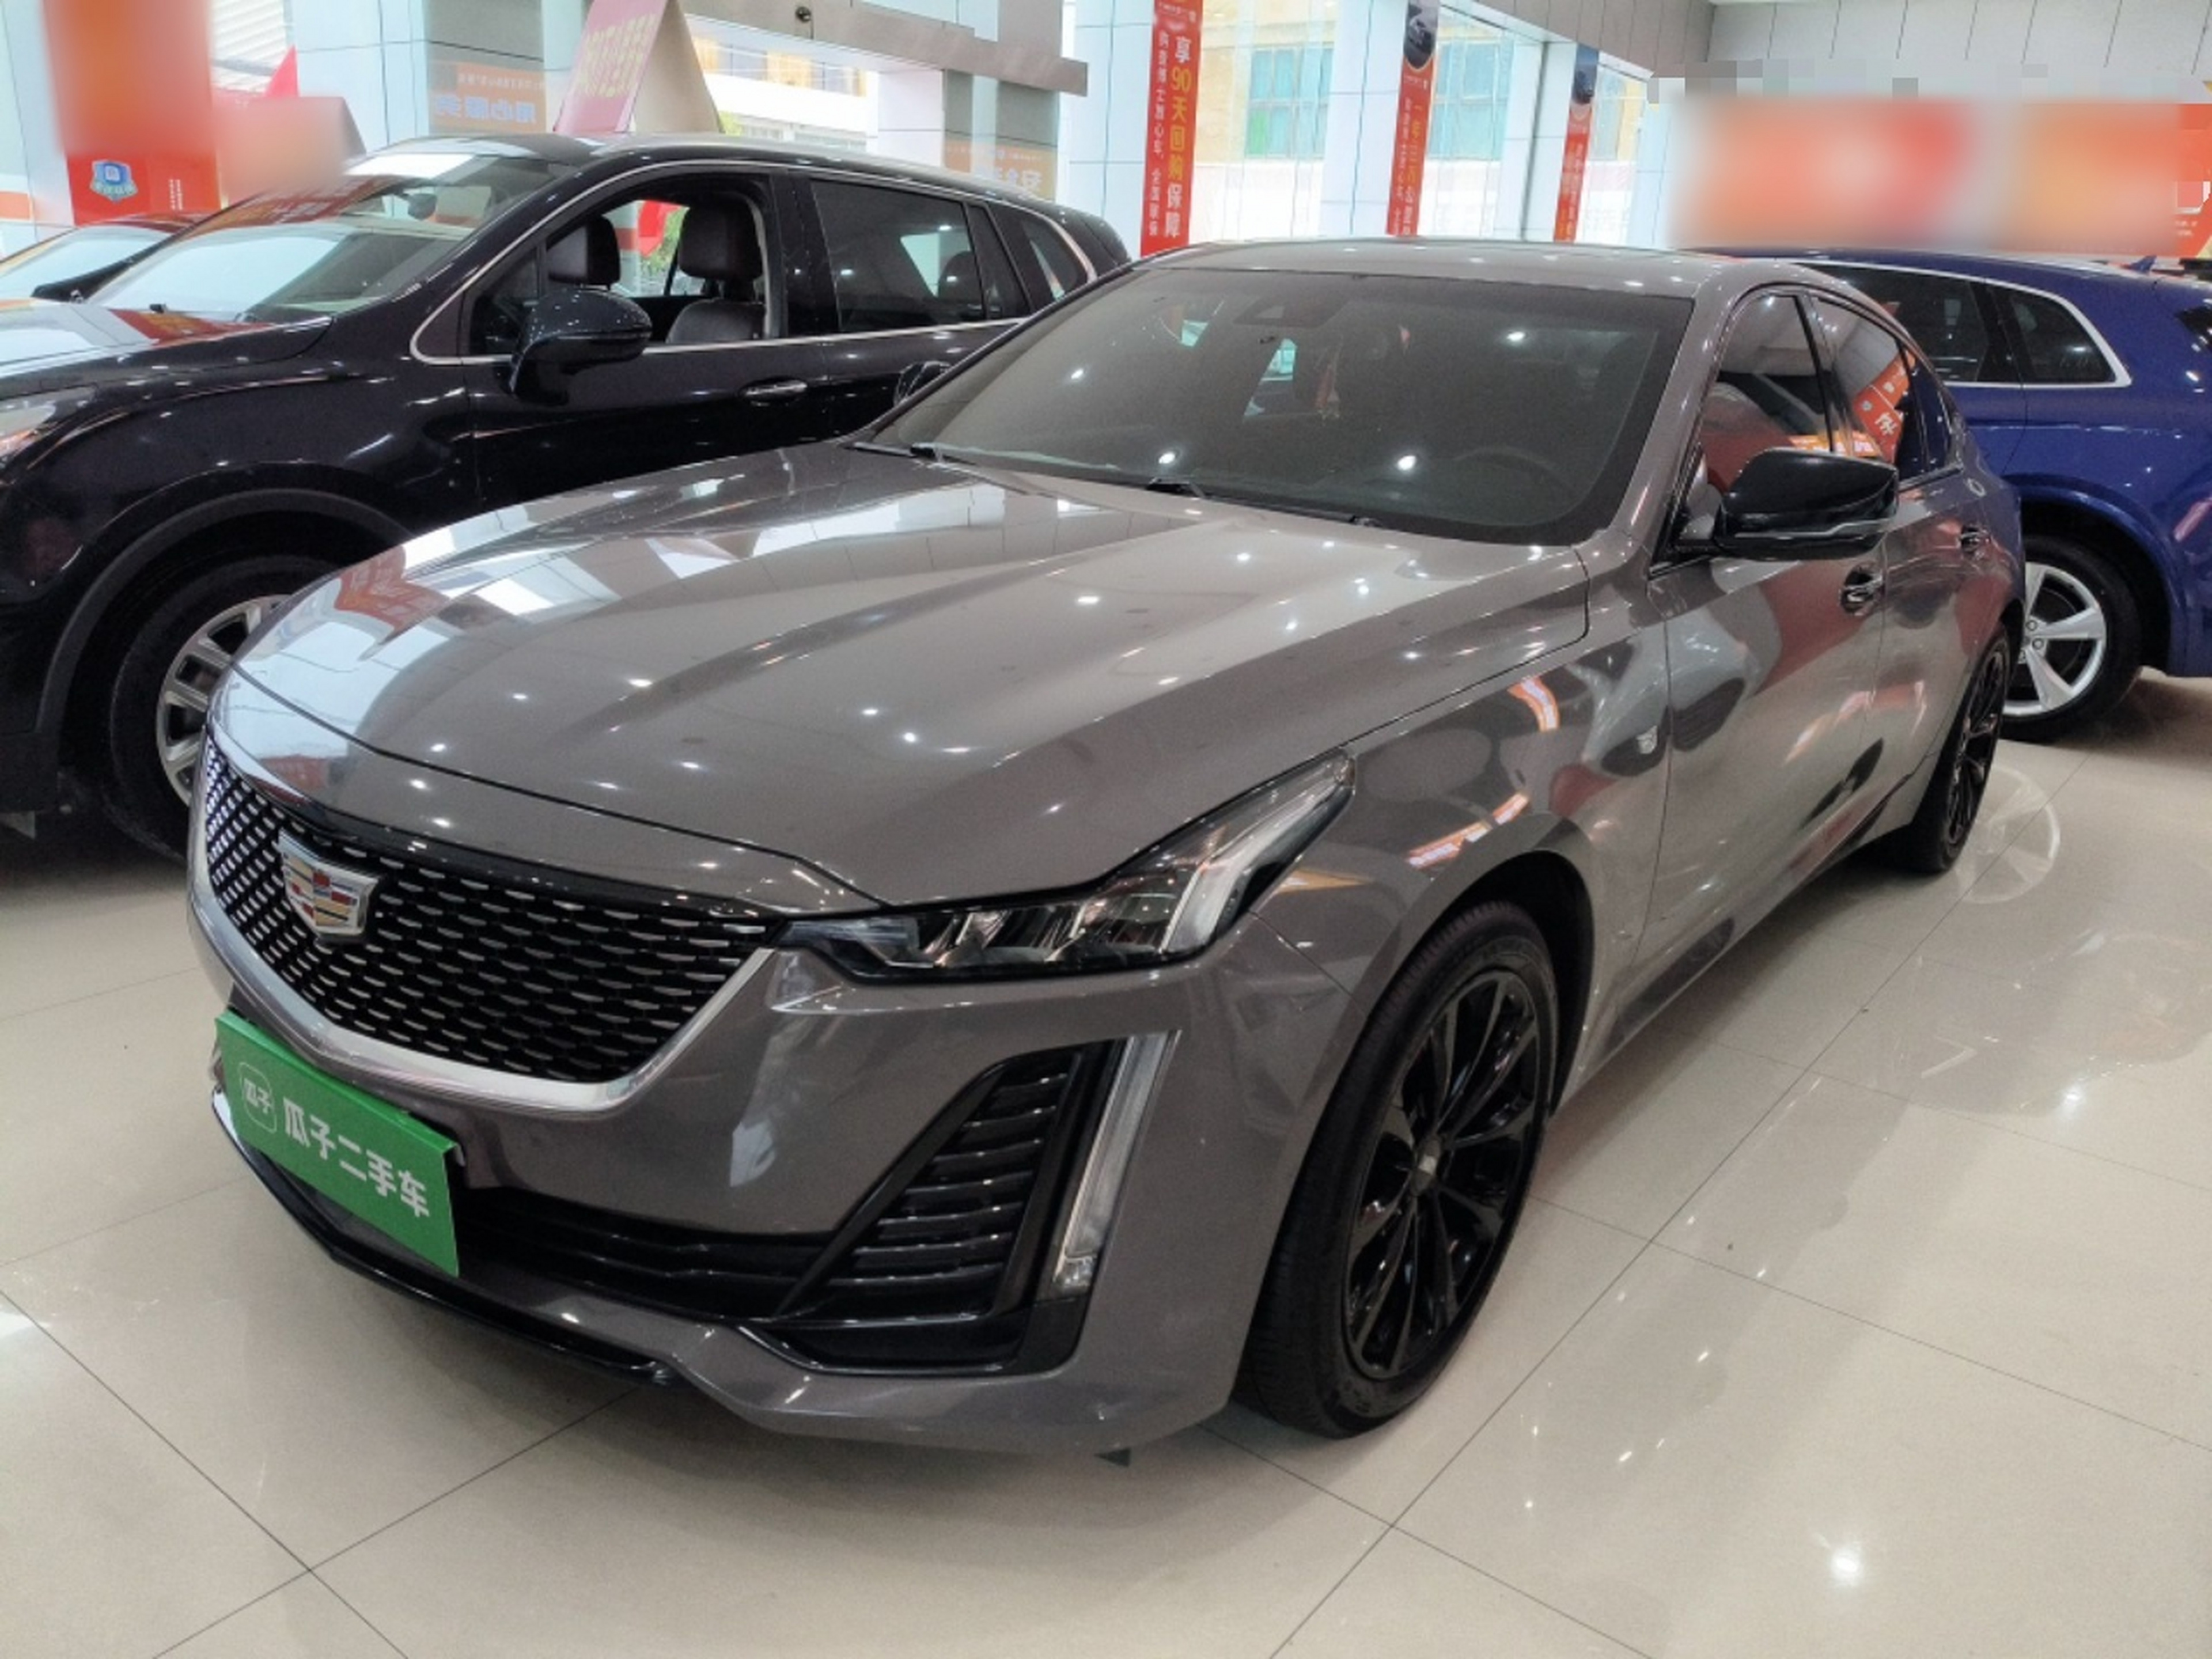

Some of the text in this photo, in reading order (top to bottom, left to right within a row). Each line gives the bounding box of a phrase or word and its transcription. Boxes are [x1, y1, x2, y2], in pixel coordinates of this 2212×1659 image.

[1164, 36, 1192, 238] 享90天回购保障
[243, 1078, 272, 1114] 瓜子
[283, 1096, 430, 1218] 瓜子二手车
